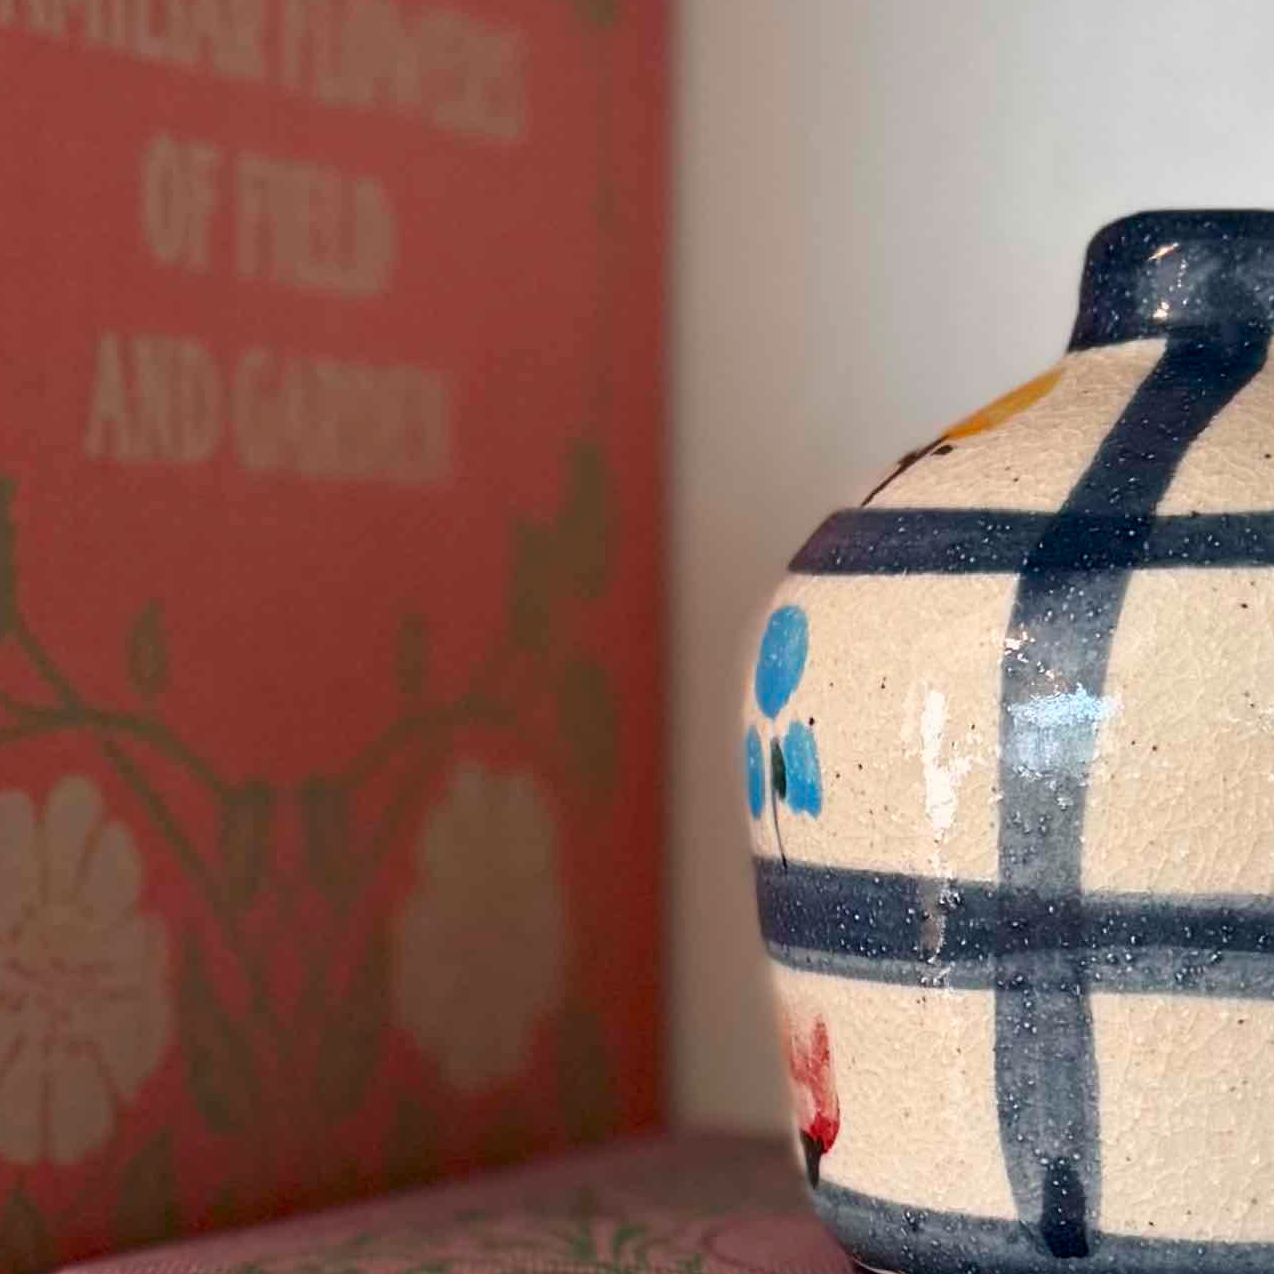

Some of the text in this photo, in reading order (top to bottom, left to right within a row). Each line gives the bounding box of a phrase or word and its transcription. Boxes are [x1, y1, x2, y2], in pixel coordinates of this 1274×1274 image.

[140, 129, 399, 298] OF FIELD
[82, 330, 454, 488] AND GARDEN
